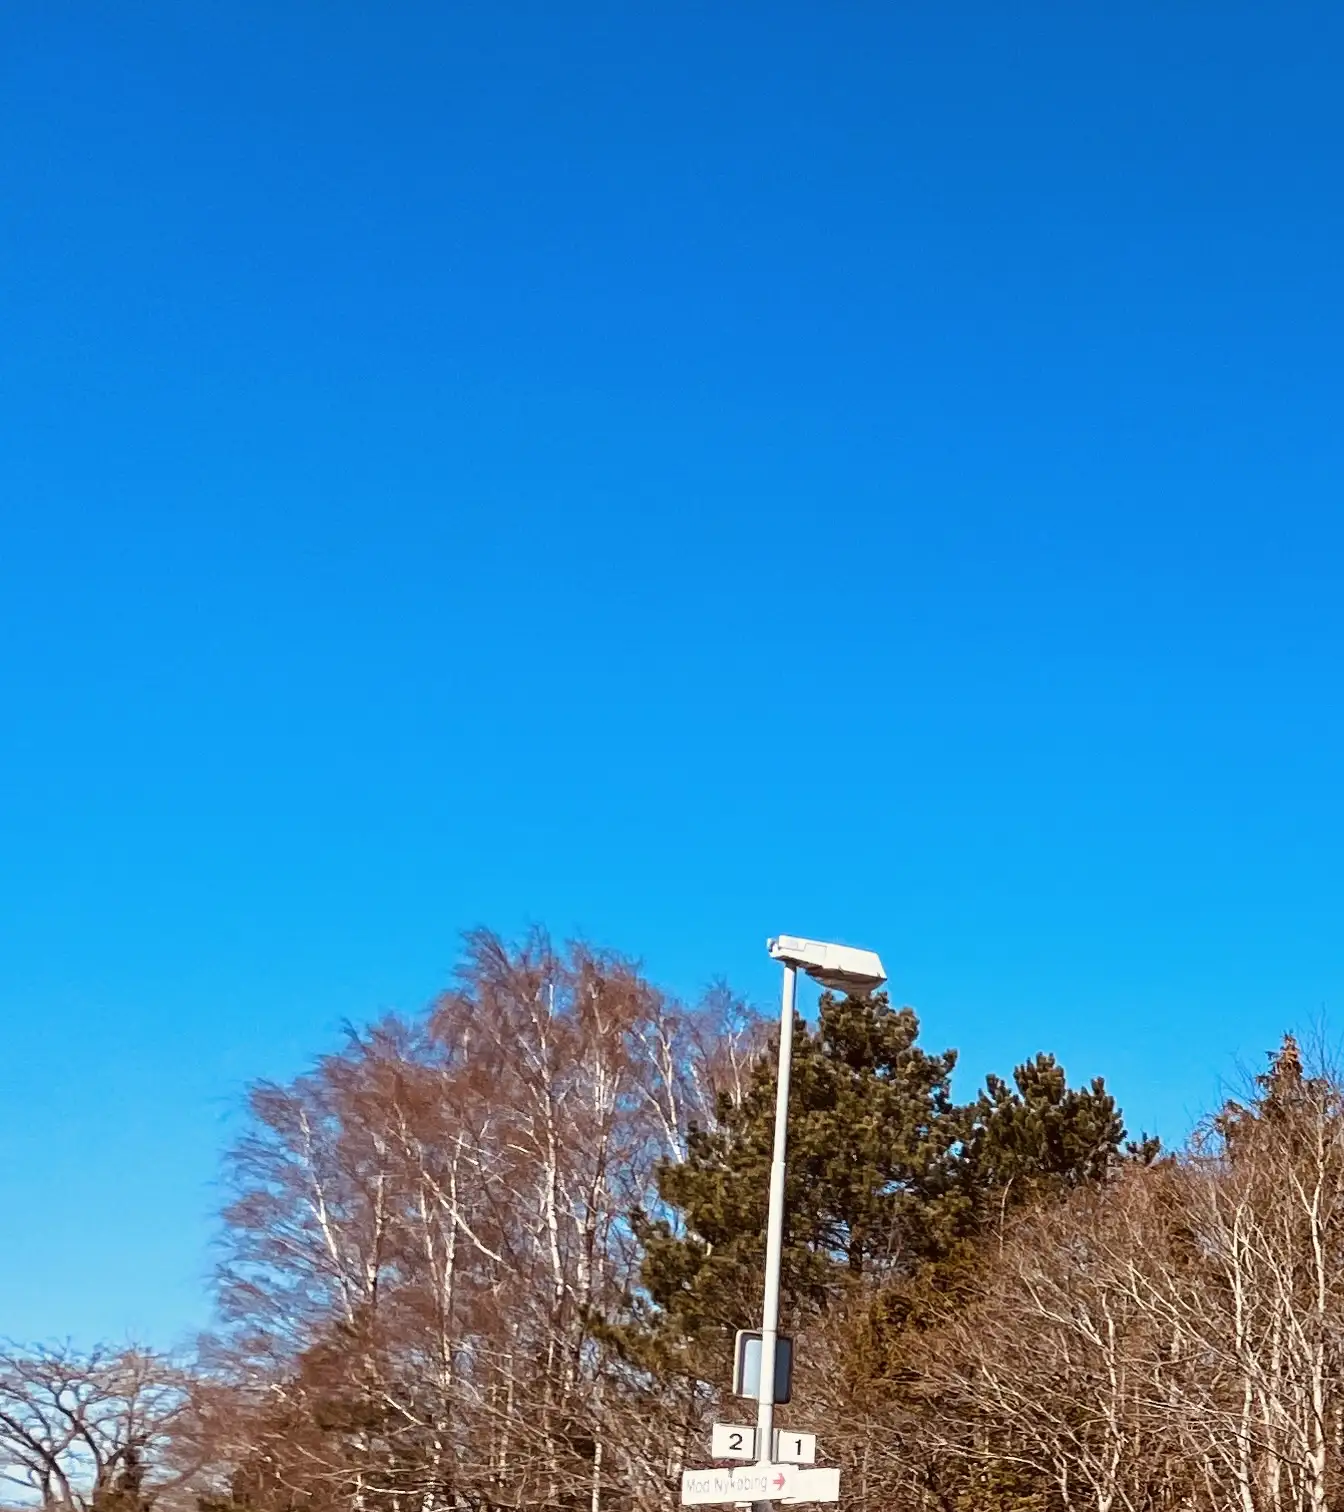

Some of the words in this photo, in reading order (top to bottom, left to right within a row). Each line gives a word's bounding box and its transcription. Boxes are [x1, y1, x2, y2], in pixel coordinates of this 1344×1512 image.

[729, 1433, 743, 1450] 2
[795, 1439, 802, 1456] 1
[686, 1479, 710, 1494] Mod
